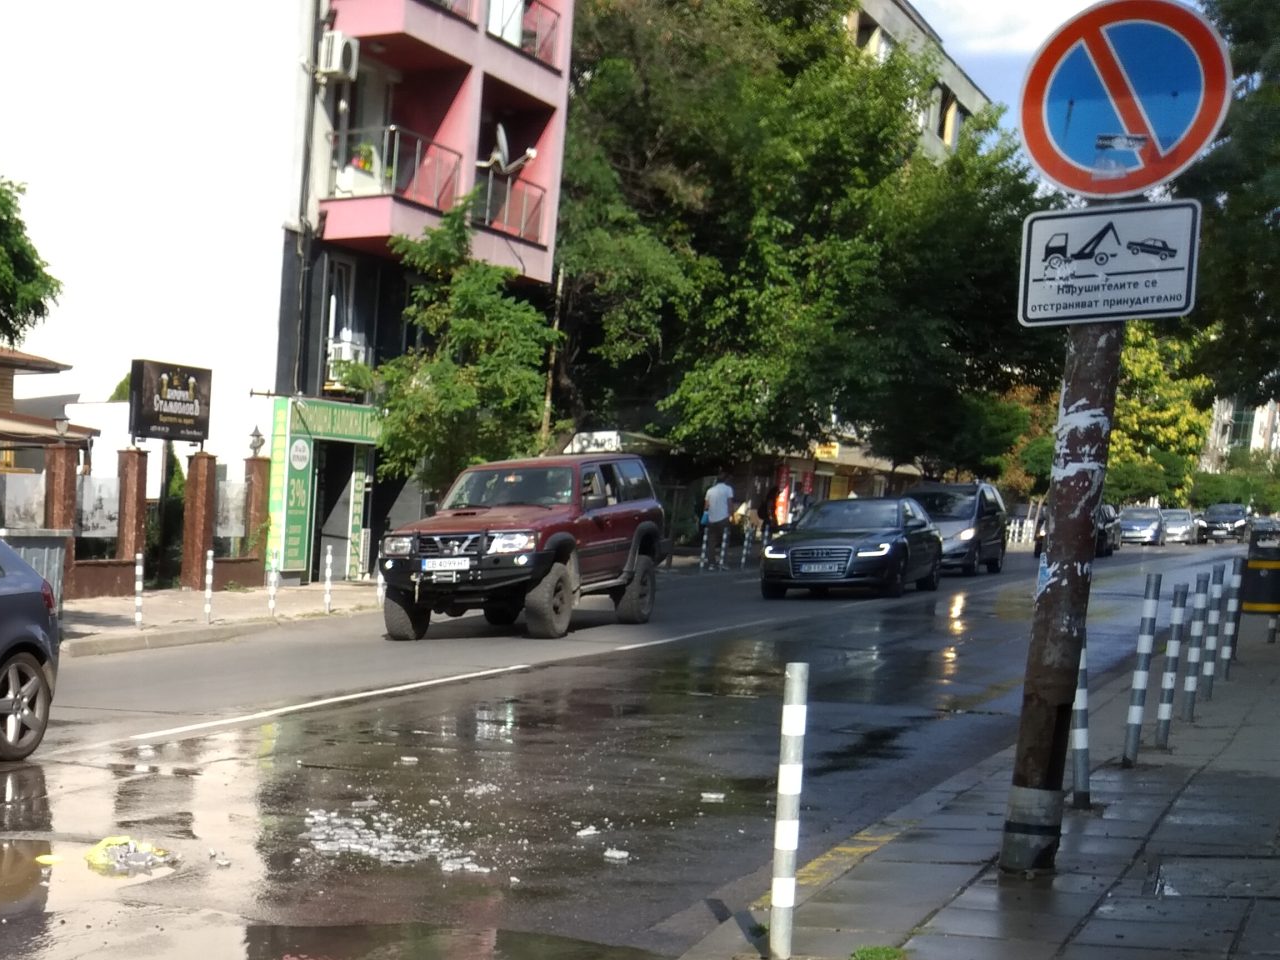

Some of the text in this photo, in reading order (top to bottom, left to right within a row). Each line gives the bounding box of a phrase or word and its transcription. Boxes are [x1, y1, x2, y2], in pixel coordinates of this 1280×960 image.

[1057, 278, 1158, 295] Нарушителите се
[1031, 293, 1183, 313] отстраняват принудително
[289, 478, 306, 507] 3%
